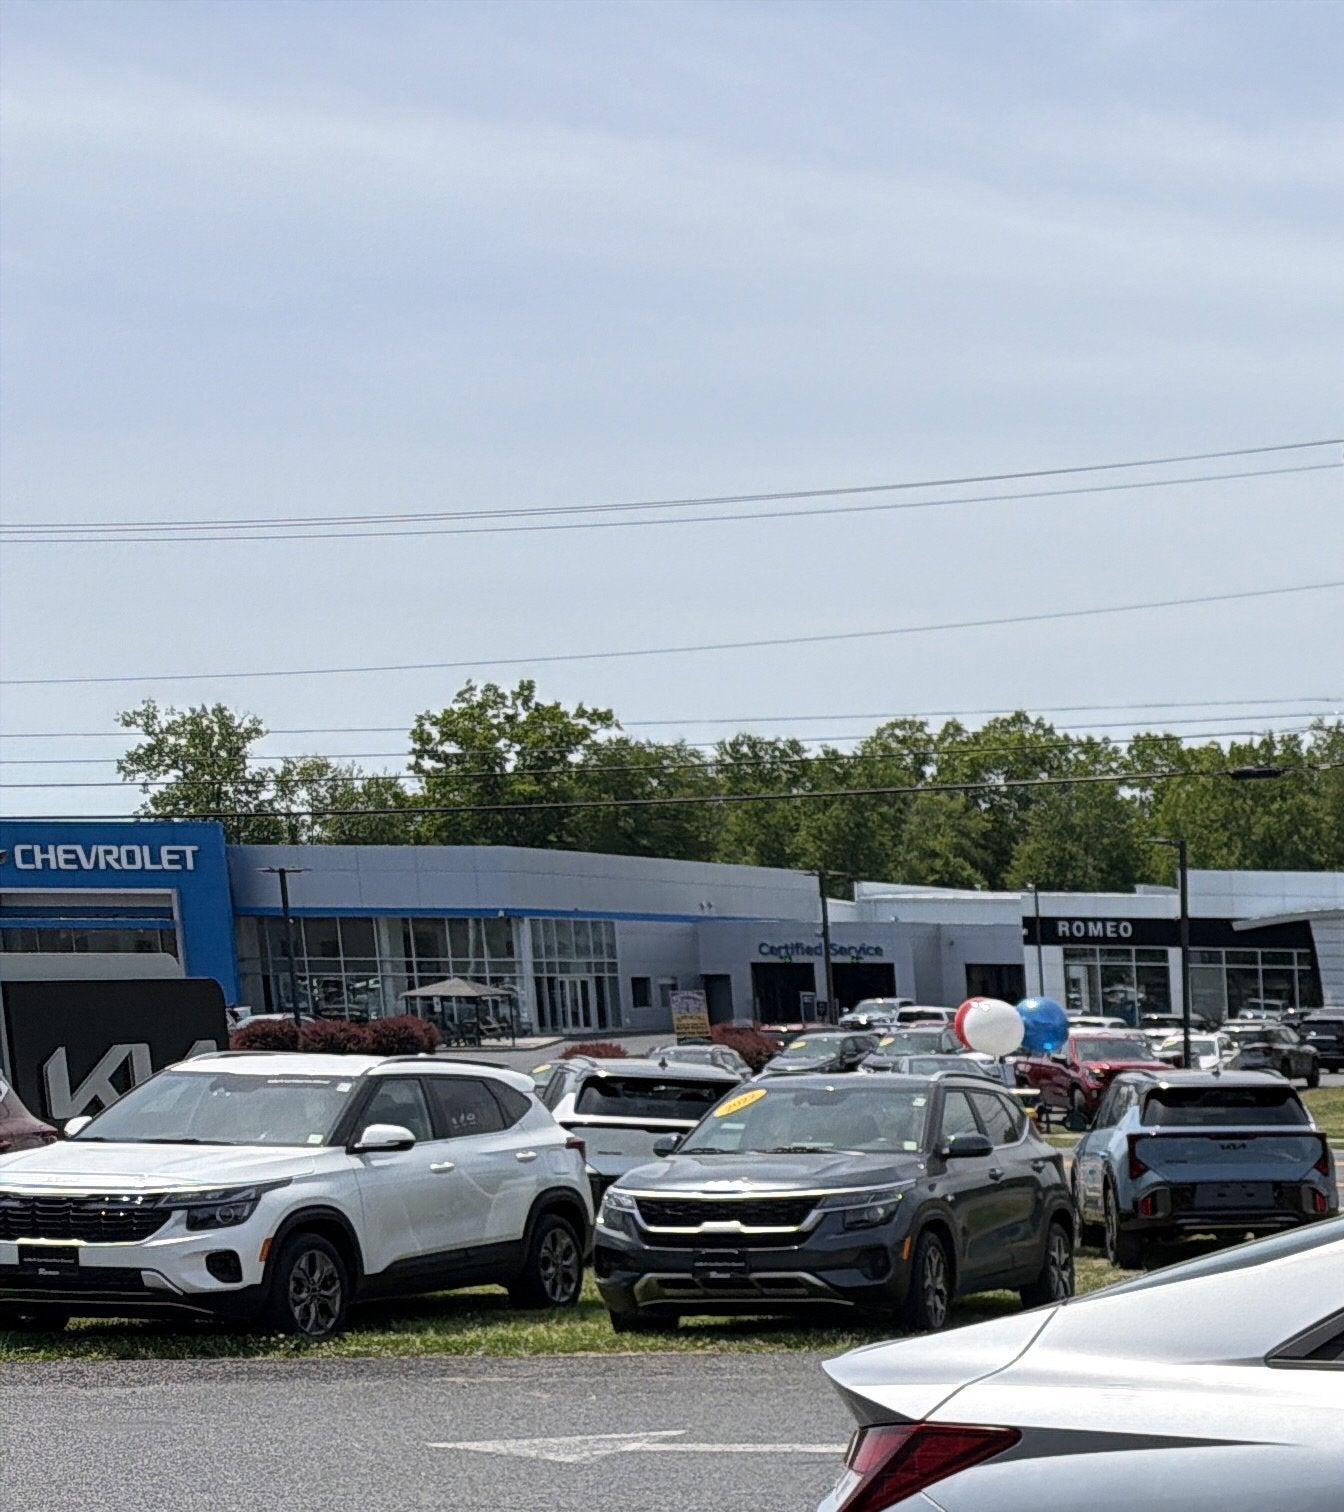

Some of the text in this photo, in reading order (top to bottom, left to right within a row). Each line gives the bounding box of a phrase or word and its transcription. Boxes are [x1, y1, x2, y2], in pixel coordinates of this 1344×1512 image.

[14, 844, 199, 871] CHEVROLET
[1057, 920, 1133, 938] ROMEO
[758, 942, 883, 957] Certified Service
